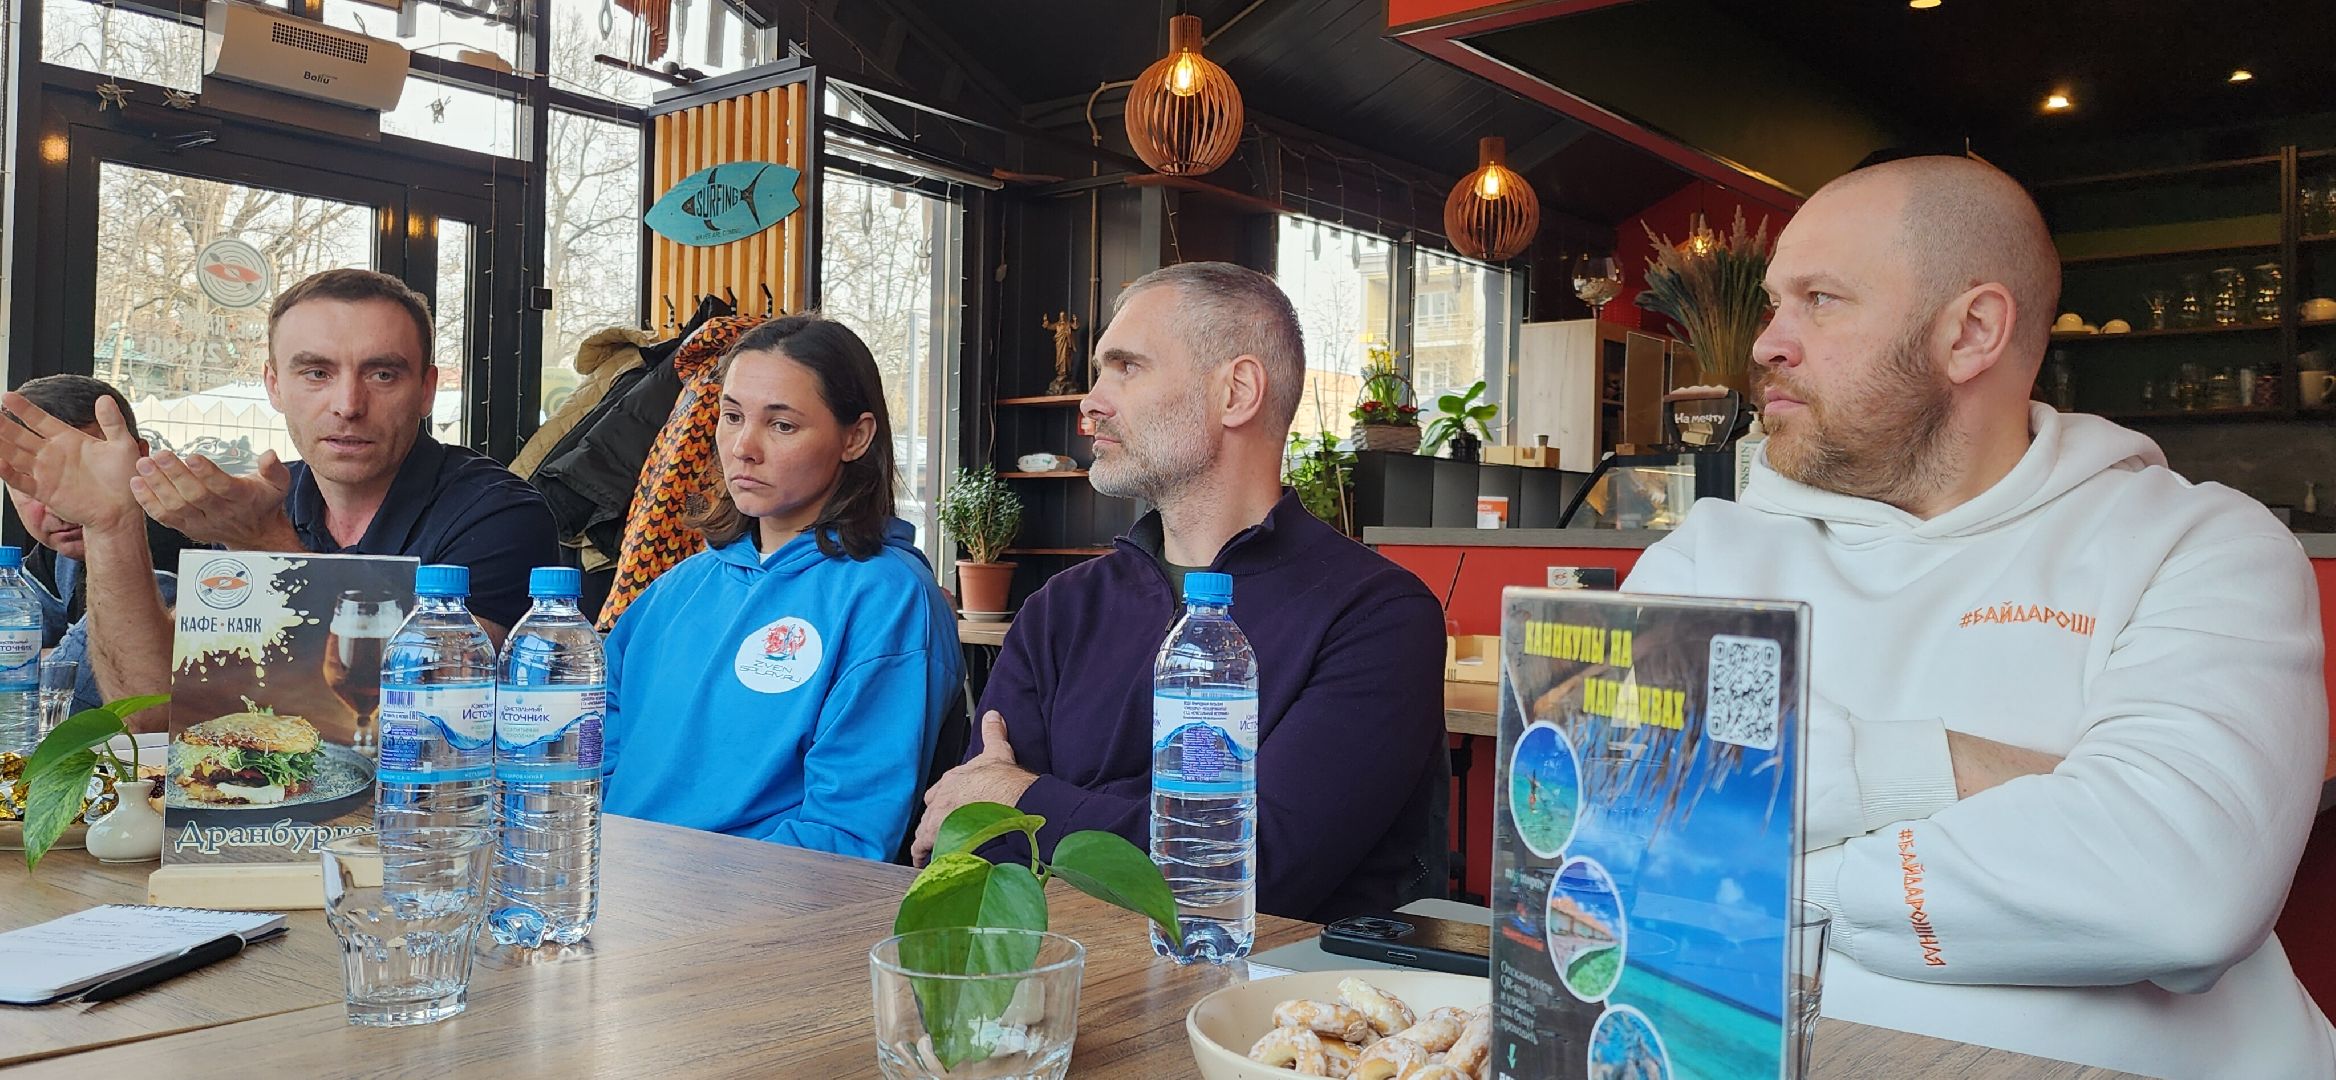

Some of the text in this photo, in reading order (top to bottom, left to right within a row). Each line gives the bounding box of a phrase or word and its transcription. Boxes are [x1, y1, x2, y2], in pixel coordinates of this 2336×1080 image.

[696, 183, 739, 217] SURFING
[1674, 412, 1726, 425] На мечту
[180, 616, 262, 633] КАФЕ КАЯК
[1524, 620, 1633, 669] КАНИКУЛЫ НА
[753, 660, 793, 673] ZVEN
[498, 711, 551, 722] Источник
[1583, 677, 1686, 731] МАЛЬДИВАХ
[1898, 827, 1947, 966] #БАЙДАРОШНАЯ
